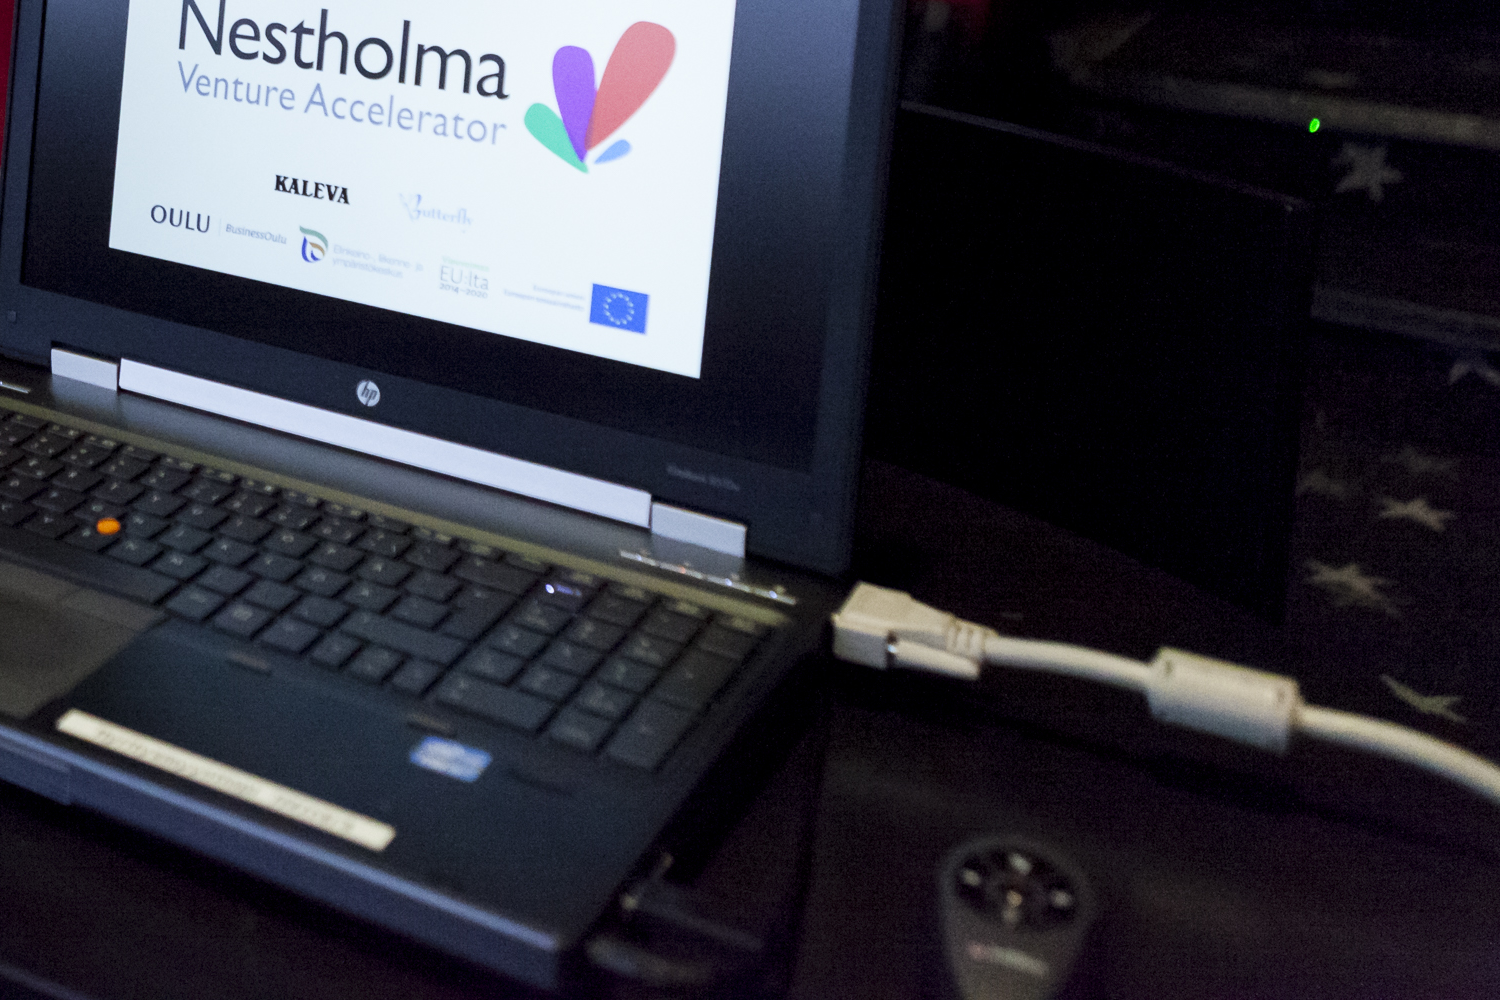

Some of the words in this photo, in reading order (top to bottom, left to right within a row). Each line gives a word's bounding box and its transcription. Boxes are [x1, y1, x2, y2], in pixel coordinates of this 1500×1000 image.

[177, 60, 296, 111] Venture
[303, 82, 507, 145] Accelerator
[274, 174, 350, 205] KALEVA
[150, 204, 211, 234] OULU
[225, 223, 288, 245] BusinessOulu
[359, 380, 379, 406] hp
